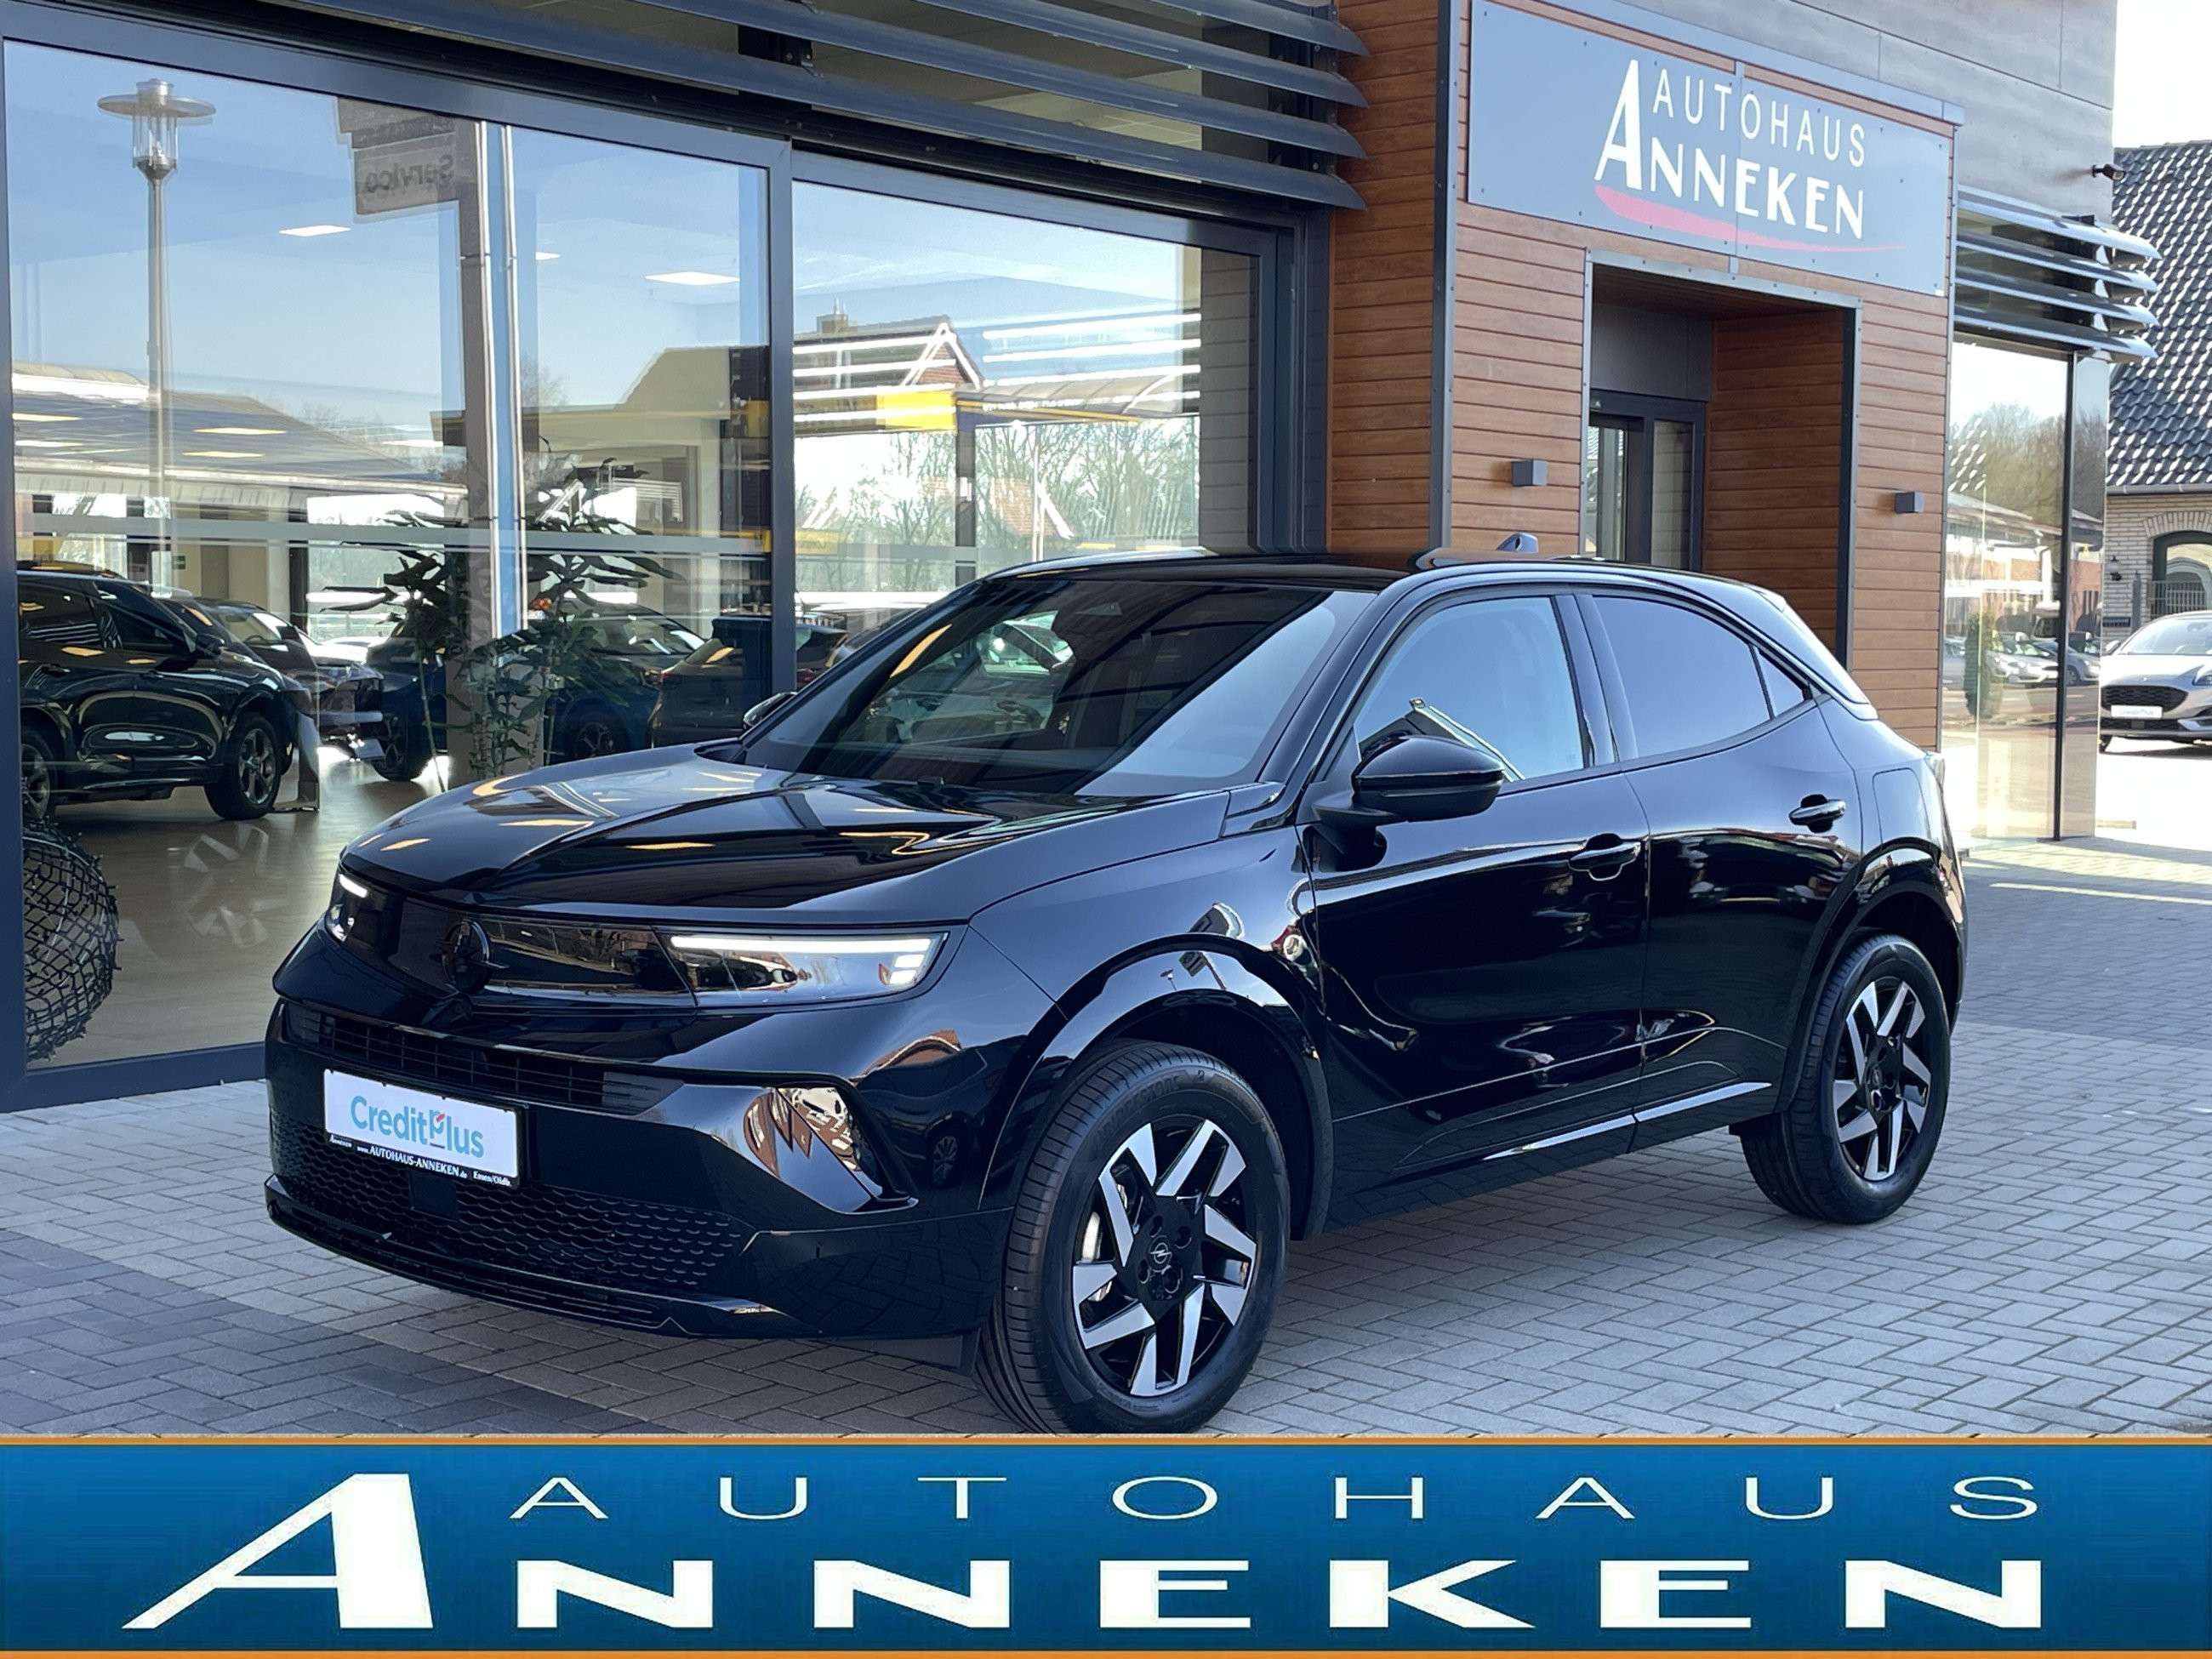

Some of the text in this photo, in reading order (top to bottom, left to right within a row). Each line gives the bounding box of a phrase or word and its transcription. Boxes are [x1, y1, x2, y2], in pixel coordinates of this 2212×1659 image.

[1593, 59, 1864, 239] ANNEKEN
[1652, 68, 1865, 168] AUTOHAUS
[350, 1095, 485, 1159] CreditPlus
